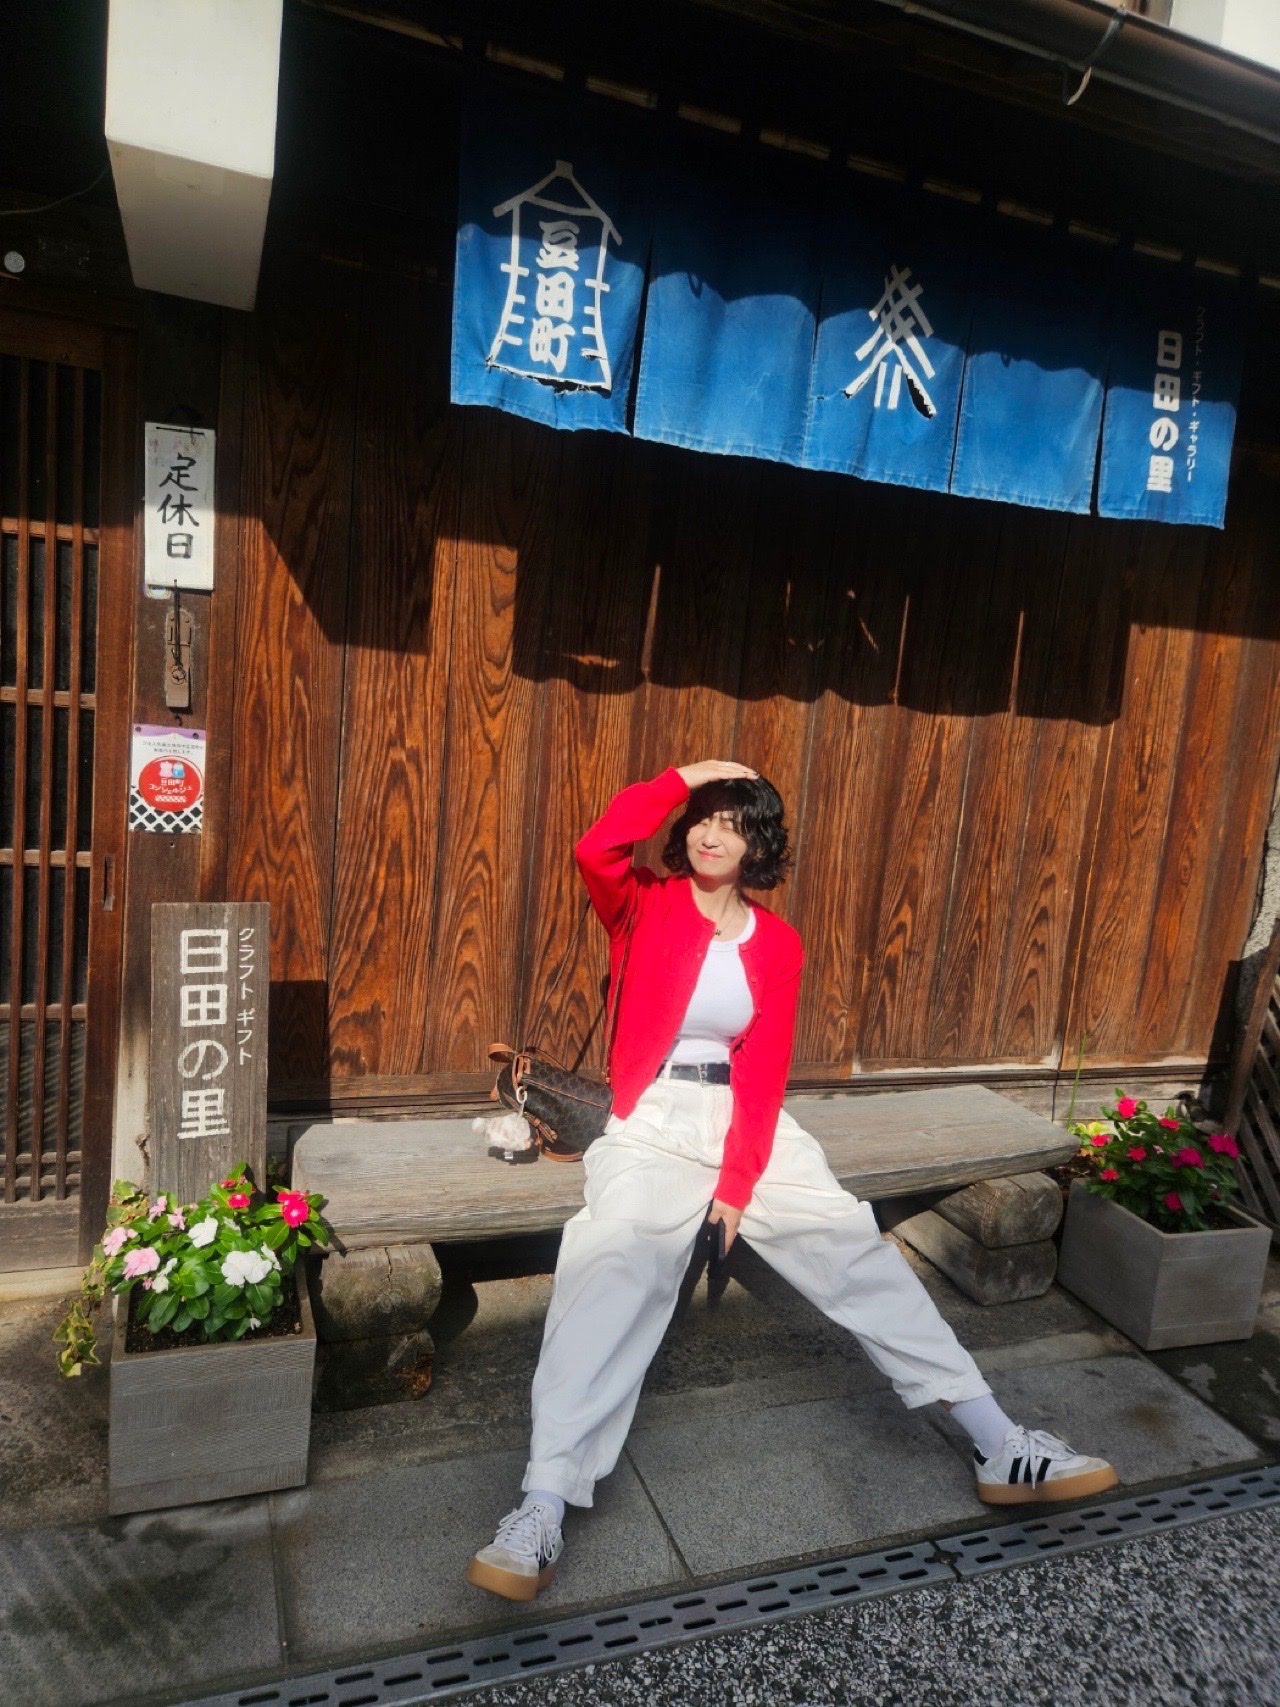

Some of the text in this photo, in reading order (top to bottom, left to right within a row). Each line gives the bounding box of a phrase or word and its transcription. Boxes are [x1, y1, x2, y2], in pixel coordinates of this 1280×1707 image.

[530, 220, 580, 373] 豆田町
[1146, 329, 1184, 494] 日田の里
[156, 452, 200, 560] 定休日
[177, 928, 231, 1139] 日田の里
